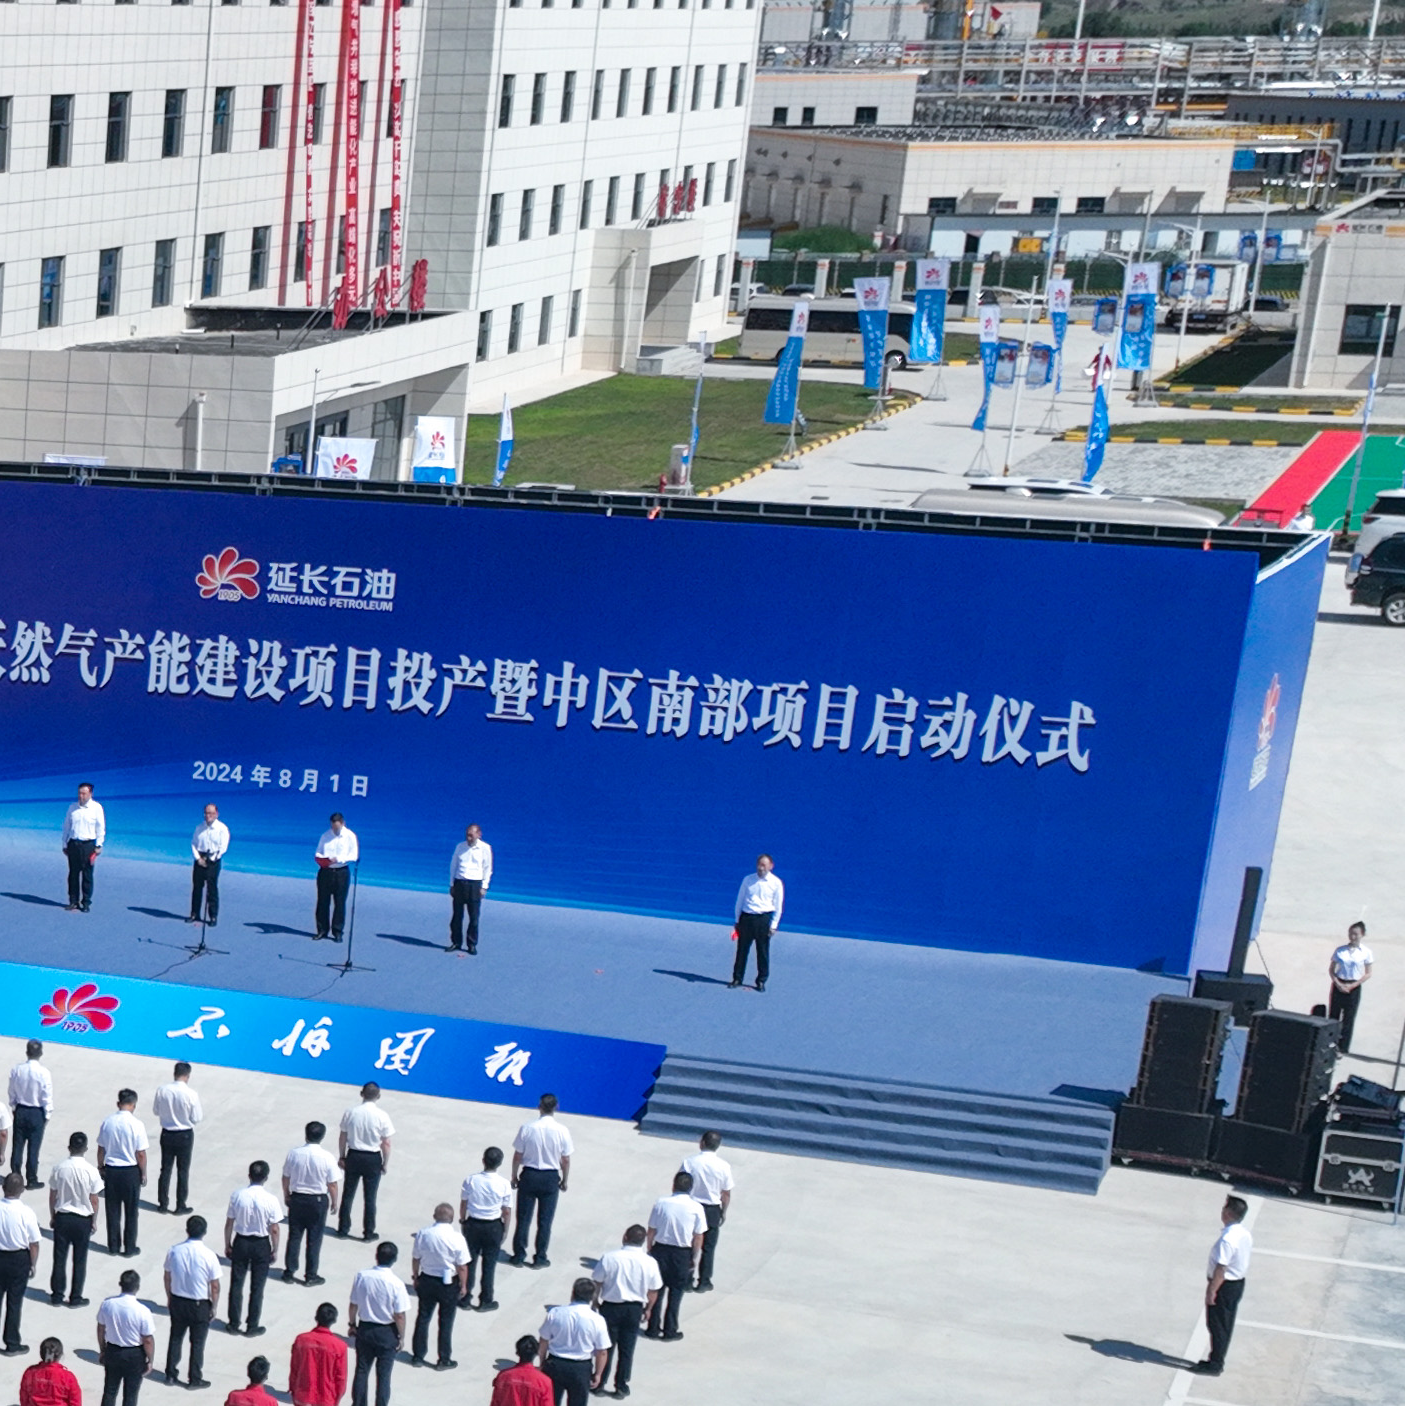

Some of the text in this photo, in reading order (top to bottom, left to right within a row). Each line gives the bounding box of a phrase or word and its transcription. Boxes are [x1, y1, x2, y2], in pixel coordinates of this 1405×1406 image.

[267, 562, 397, 600] 延长石油
[218, 589, 241, 601] 1905
[266, 592, 394, 612] YANCHANG PETROLEUM
